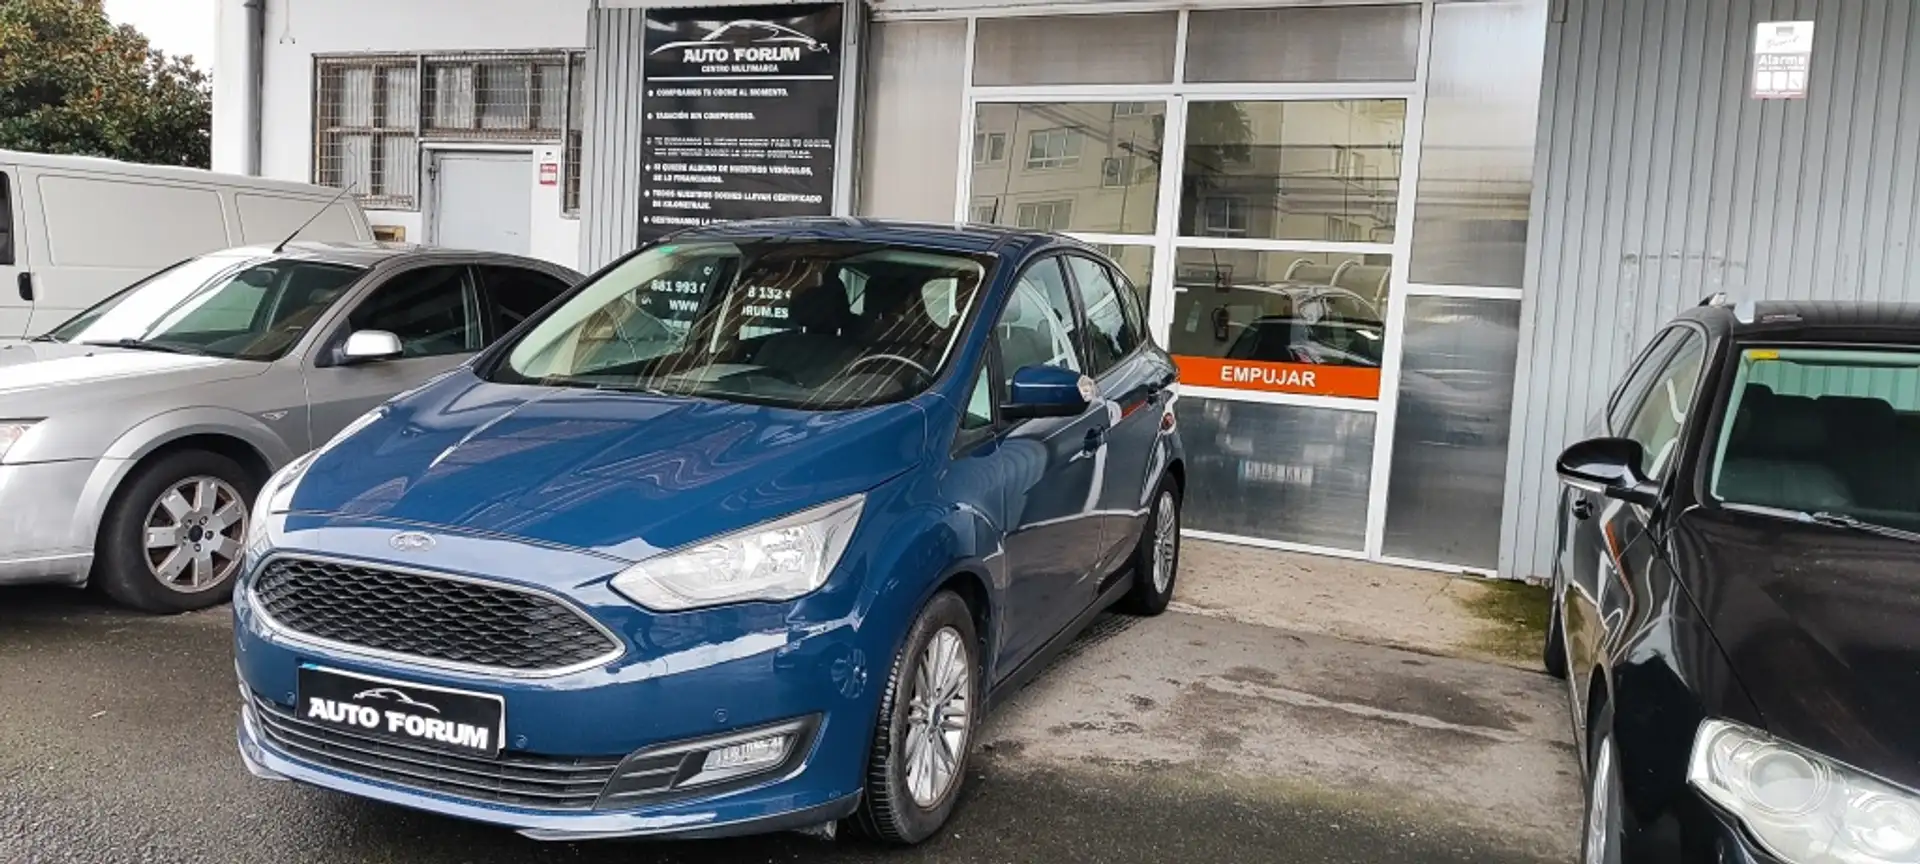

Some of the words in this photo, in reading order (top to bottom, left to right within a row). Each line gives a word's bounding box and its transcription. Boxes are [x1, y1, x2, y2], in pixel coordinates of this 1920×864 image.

[683, 48, 729, 62] AUTO
[733, 47, 800, 61] FORUM
[759, 286, 783, 300] 132
[1221, 366, 1317, 388] EMPUJAR
[307, 697, 380, 728] AUTO
[384, 710, 489, 749] FORUM
